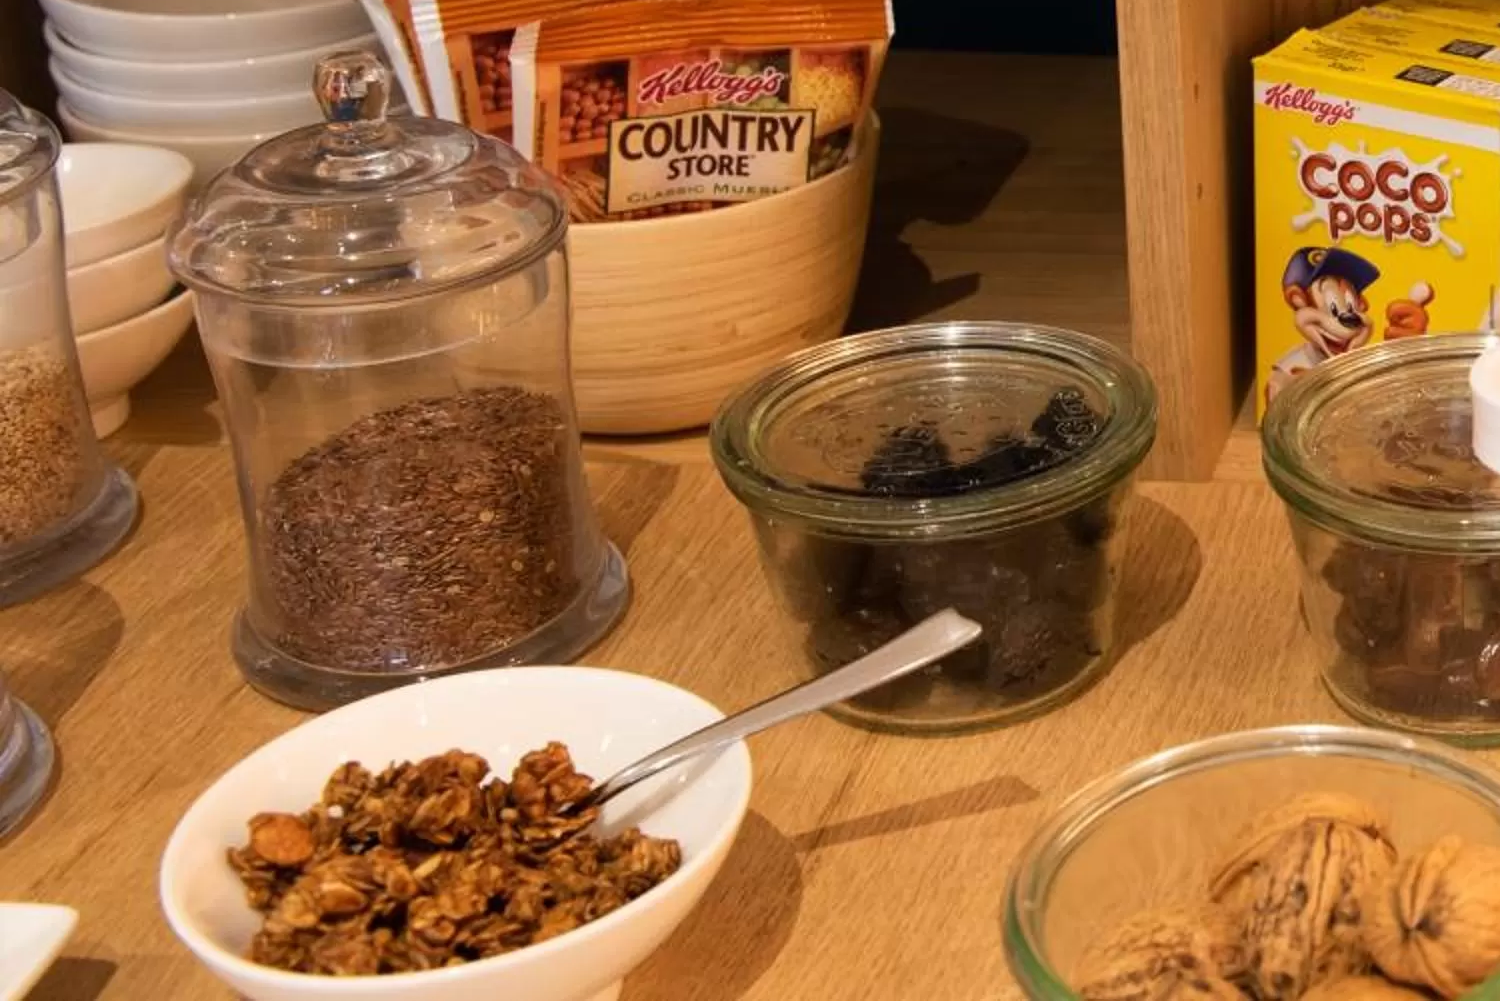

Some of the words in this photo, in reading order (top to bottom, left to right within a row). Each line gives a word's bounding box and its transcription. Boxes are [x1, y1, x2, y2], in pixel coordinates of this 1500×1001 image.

[641, 61, 782, 103] Kellogg's
[1264, 83, 1356, 125] Kellogg's
[618, 113, 803, 160] COUNTRY
[666, 155, 751, 180] STORE
[1300, 153, 1448, 213] COCO
